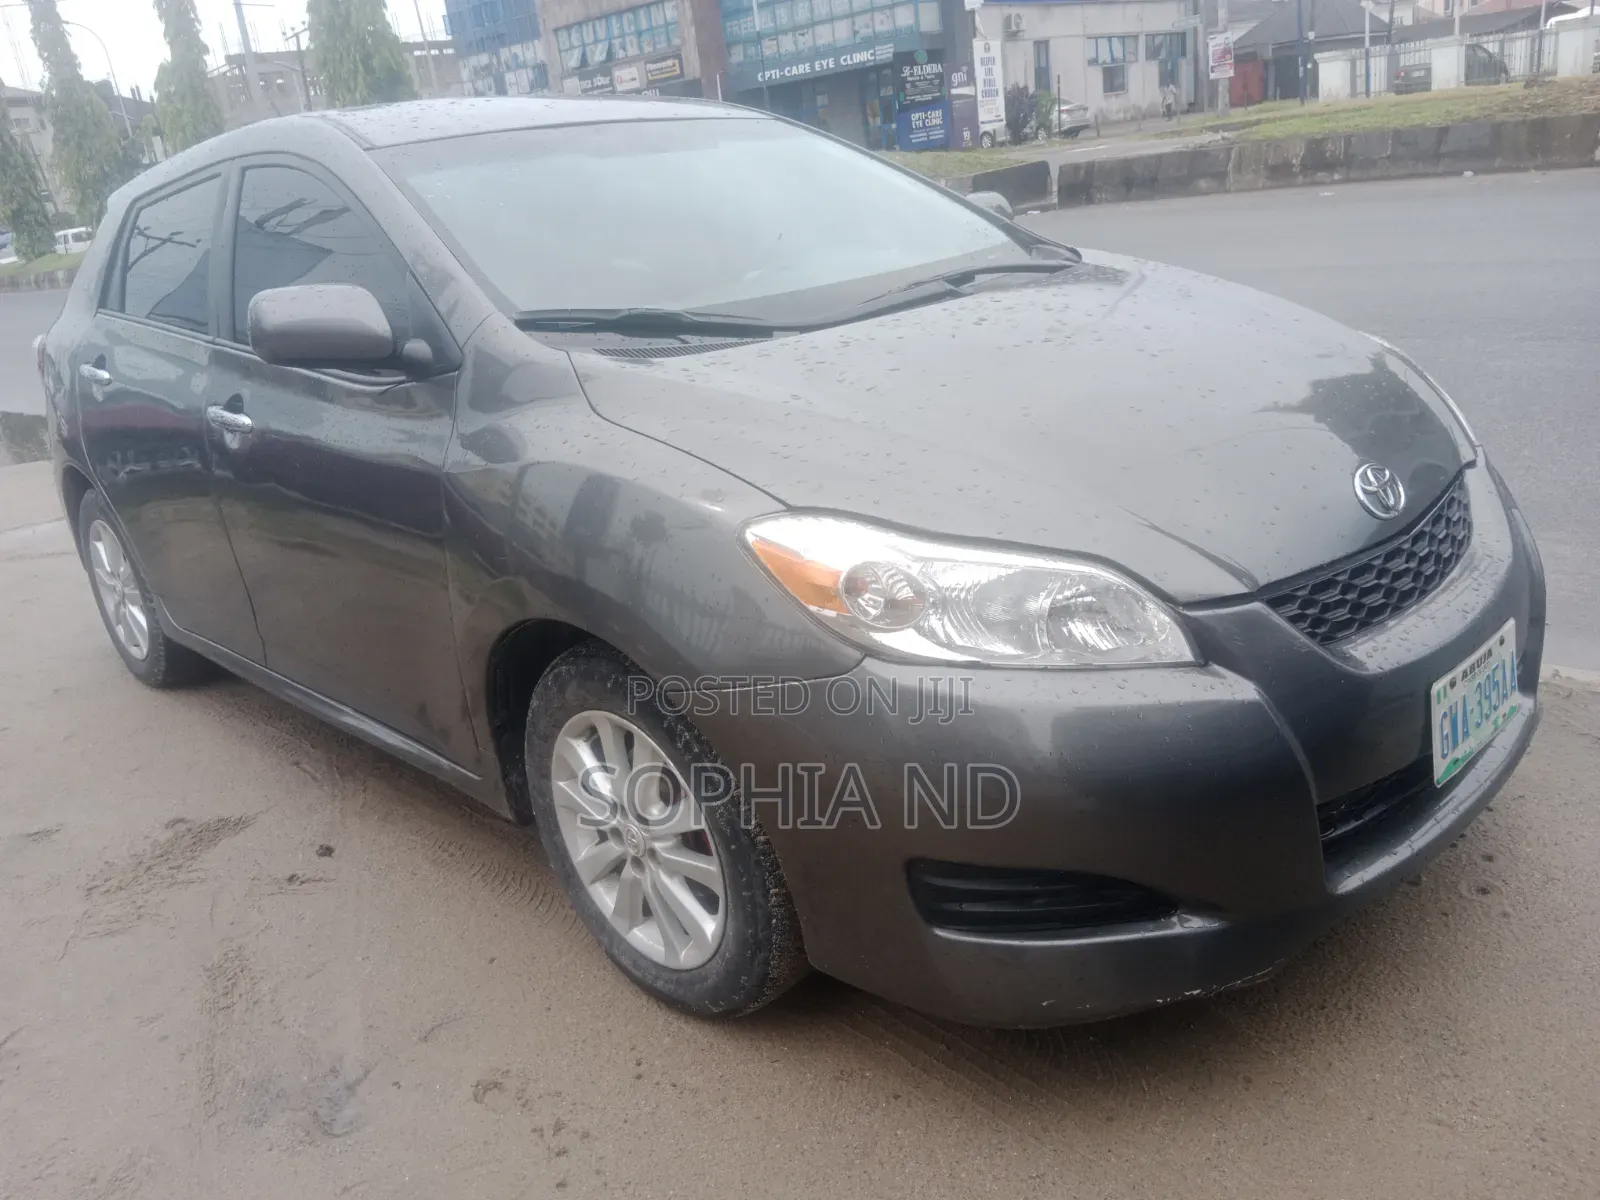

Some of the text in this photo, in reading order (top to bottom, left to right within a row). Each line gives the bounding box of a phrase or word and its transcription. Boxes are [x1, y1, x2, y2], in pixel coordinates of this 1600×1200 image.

[758, 62, 811, 82] OPTI-CARE
[815, 57, 836, 71] EYE
[840, 49, 876, 66] CLINIC
[983, 77, 996, 88] BIBLE
[981, 87, 999, 99] CHURCH
[911, 110, 942, 120] OPTI-CARE
[912, 118, 943, 129] EYE CLINIC
[1461, 648, 1493, 682] ABUJA
